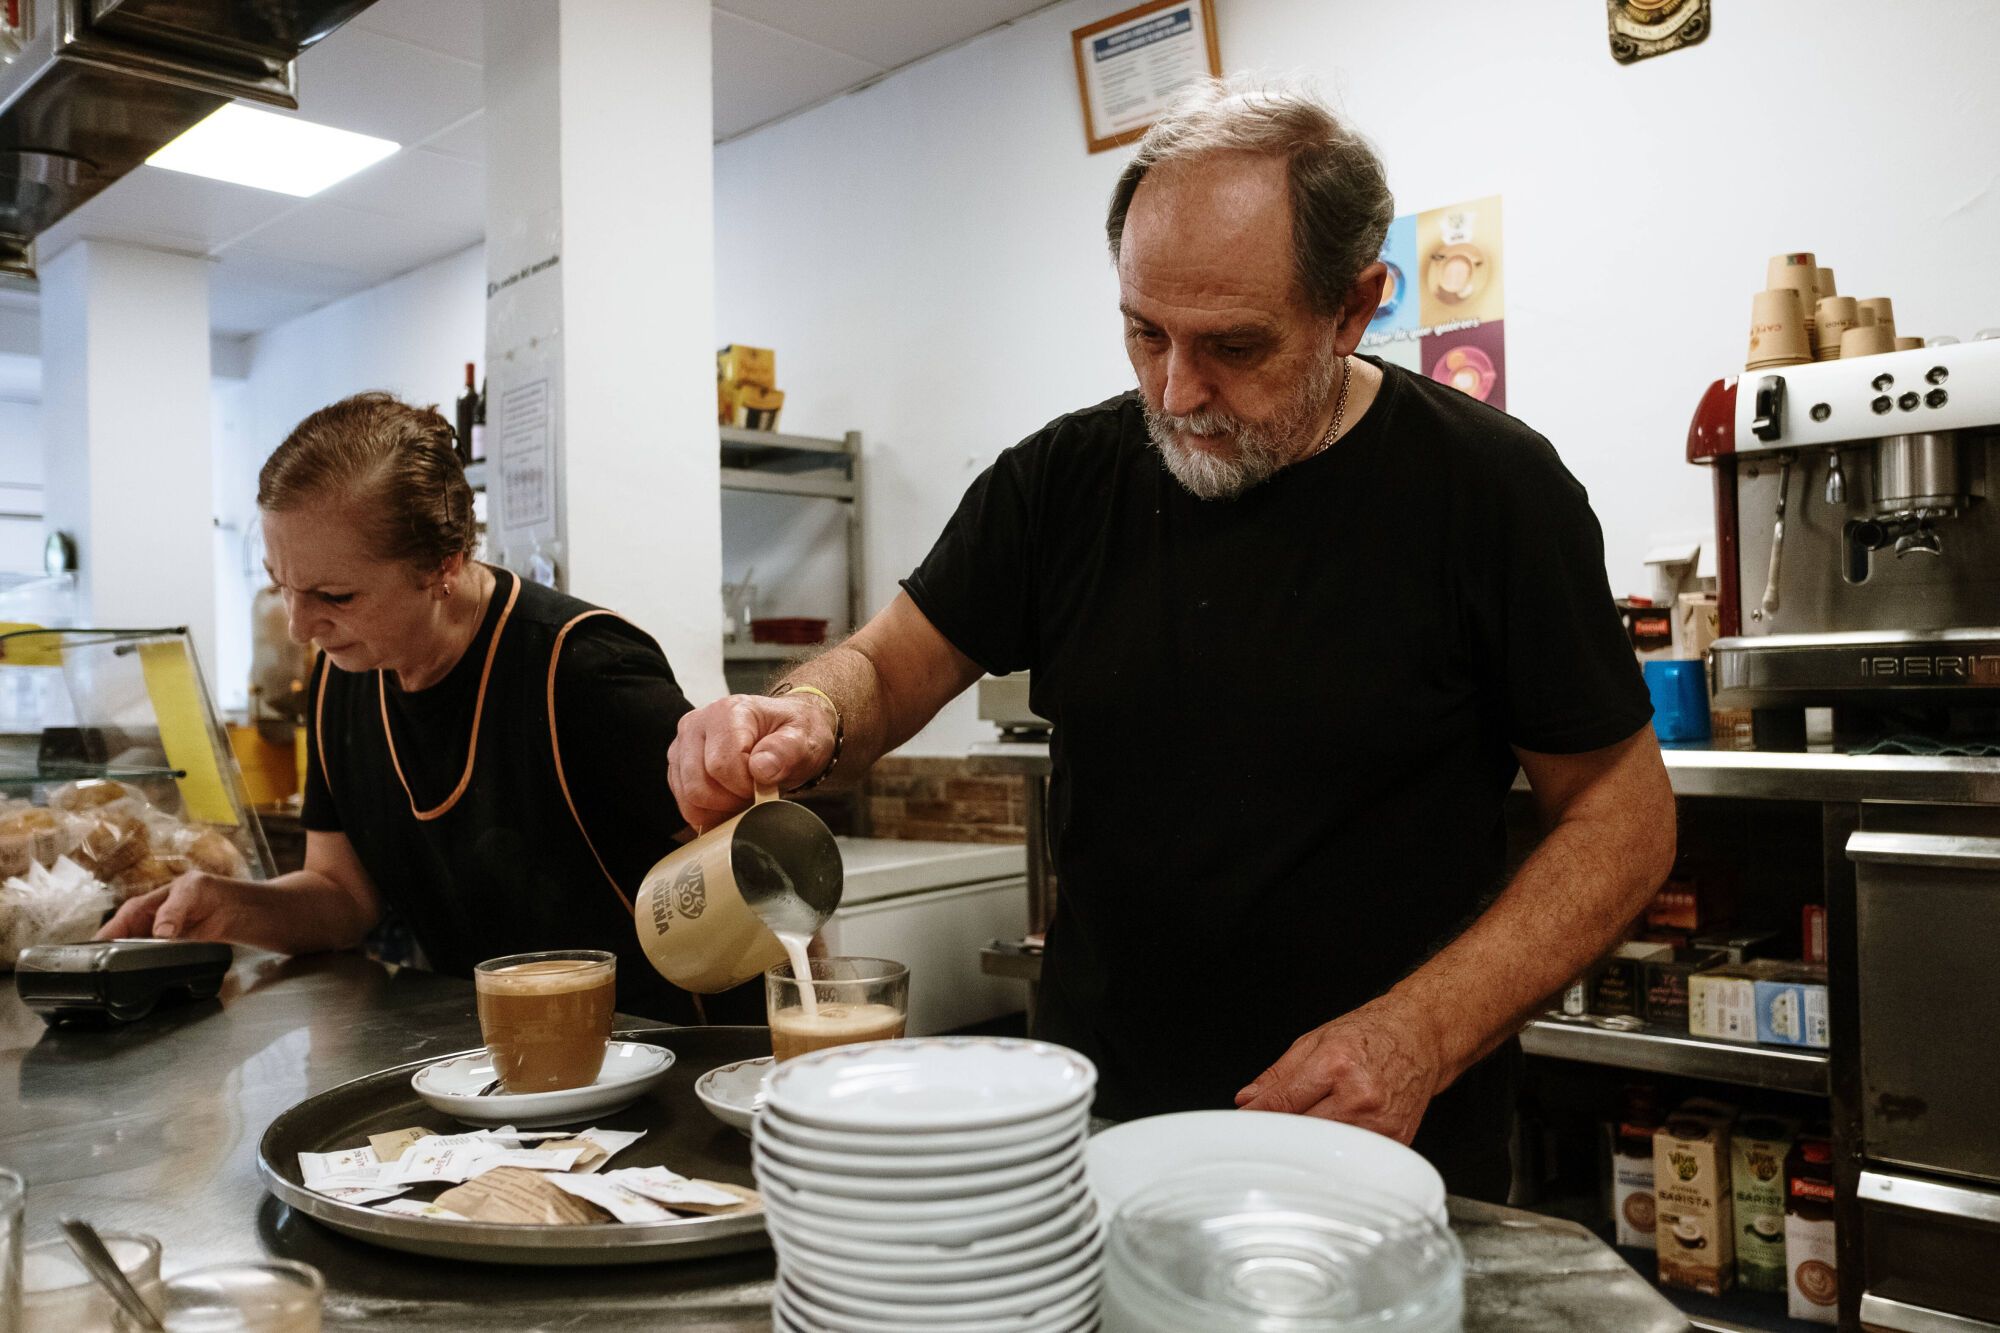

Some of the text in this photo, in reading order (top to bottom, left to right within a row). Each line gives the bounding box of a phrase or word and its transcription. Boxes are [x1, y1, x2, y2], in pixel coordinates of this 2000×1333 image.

[652, 878, 671, 936] AVENA
[1658, 1190, 1712, 1209] BARISTA
[1736, 1191, 1782, 1208] BARIST
[1794, 1181, 1834, 1200] Pascua
